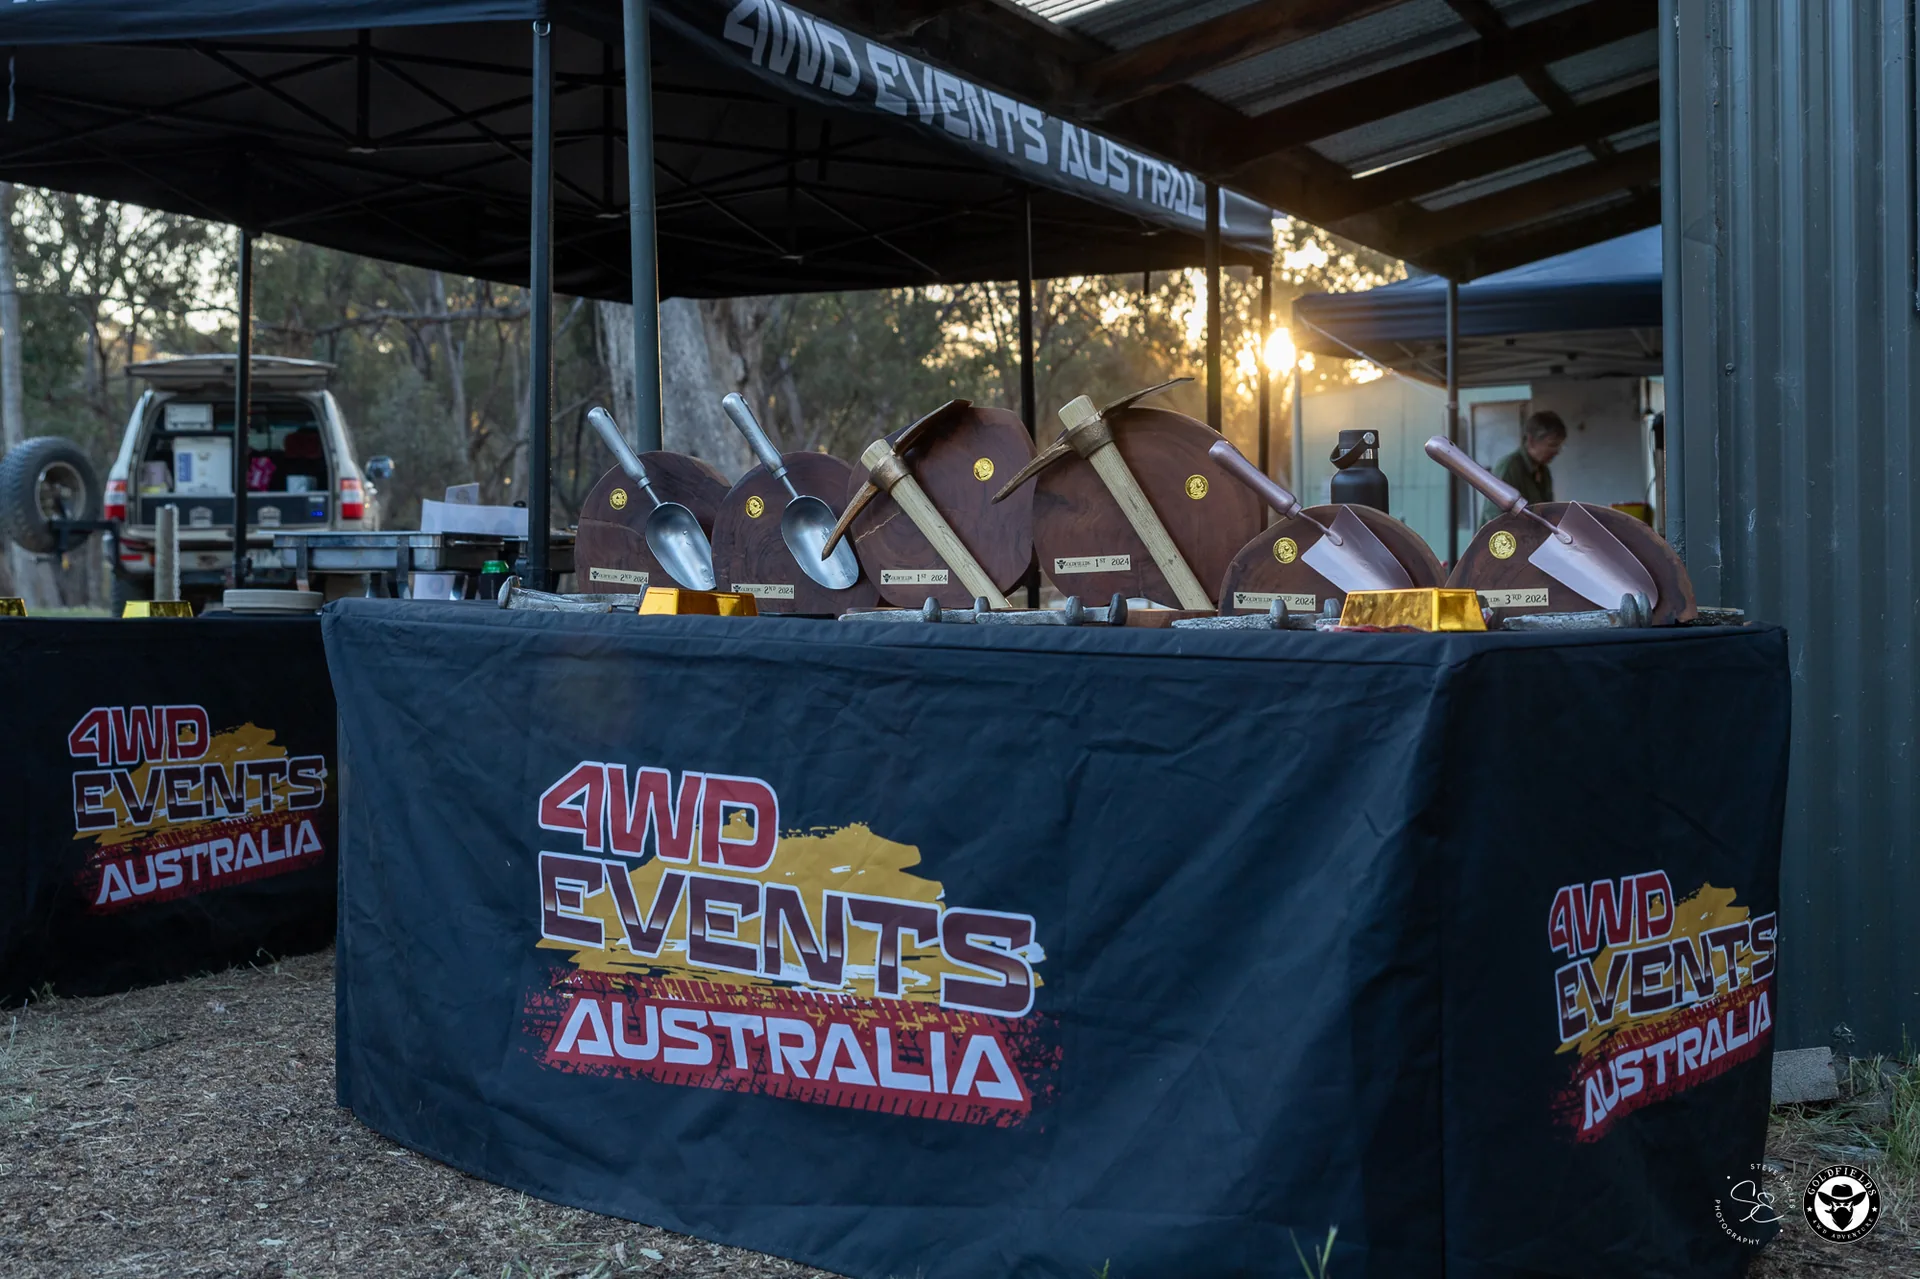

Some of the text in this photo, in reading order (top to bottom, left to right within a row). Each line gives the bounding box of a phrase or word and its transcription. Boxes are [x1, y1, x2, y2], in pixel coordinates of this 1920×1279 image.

[723, 0, 1229, 230] 4WD EVENTS AUSTRAL
[620, 573, 632, 582] 2ND
[633, 575, 648, 583] 2024
[763, 585, 777, 595] 2ND
[778, 586, 794, 595] 2024
[916, 573, 927, 583] 1ST
[930, 574, 948, 582] 2024
[1095, 557, 1107, 568] 1ST
[1111, 557, 1130, 566] 2024
[1294, 596, 1315, 606] 2024
[1504, 594, 1522, 605] 3RD
[1525, 594, 1548, 604] 2024
[68, 704, 211, 767] 4WD
[73, 755, 327, 832] EVENTS
[538, 760, 779, 874] 4WD
[95, 819, 323, 906] AUSTRALIA
[538, 851, 1037, 1018] EVENTS
[1548, 869, 1675, 958] 4WD
[1555, 911, 1777, 1044] EVENTS
[554, 998, 1025, 1101] AUSTRALIA
[1582, 991, 1772, 1131] AUSTRALIA
